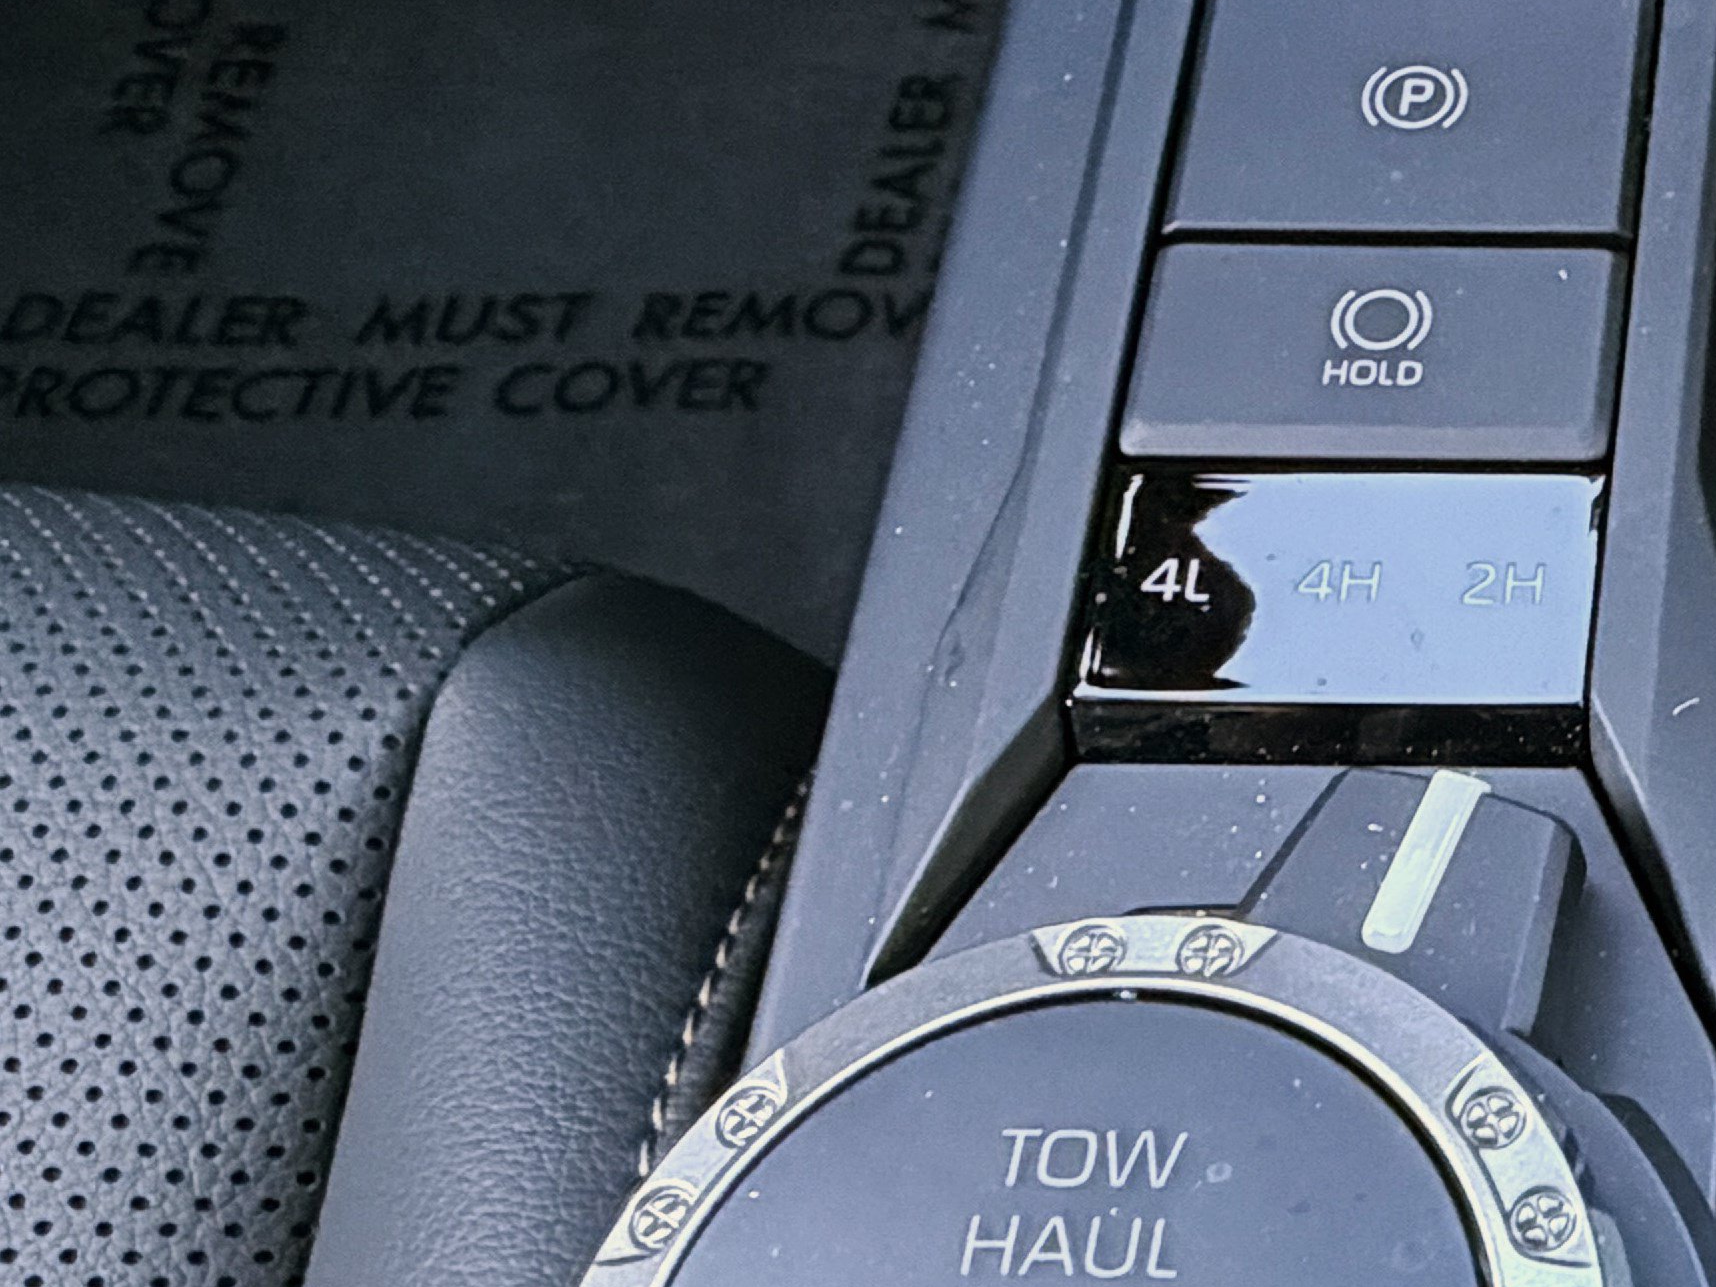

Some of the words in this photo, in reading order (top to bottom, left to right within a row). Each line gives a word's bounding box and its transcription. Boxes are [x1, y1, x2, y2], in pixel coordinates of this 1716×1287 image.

[126, 23, 288, 275] REMOVE
[835, 73, 964, 278] DEALER
[0, 289, 308, 348] DEALER
[352, 287, 600, 345] MUST
[630, 285, 935, 344] REMOV
[490, 356, 776, 417] COVER
[1321, 359, 1424, 387] HOLD
[1141, 557, 1211, 603] 4L
[1296, 560, 1384, 603] 4H
[1461, 561, 1547, 607] 2H
[1001, 1128, 1189, 1190] TOW
[959, 1215, 1179, 1280] HAUL
